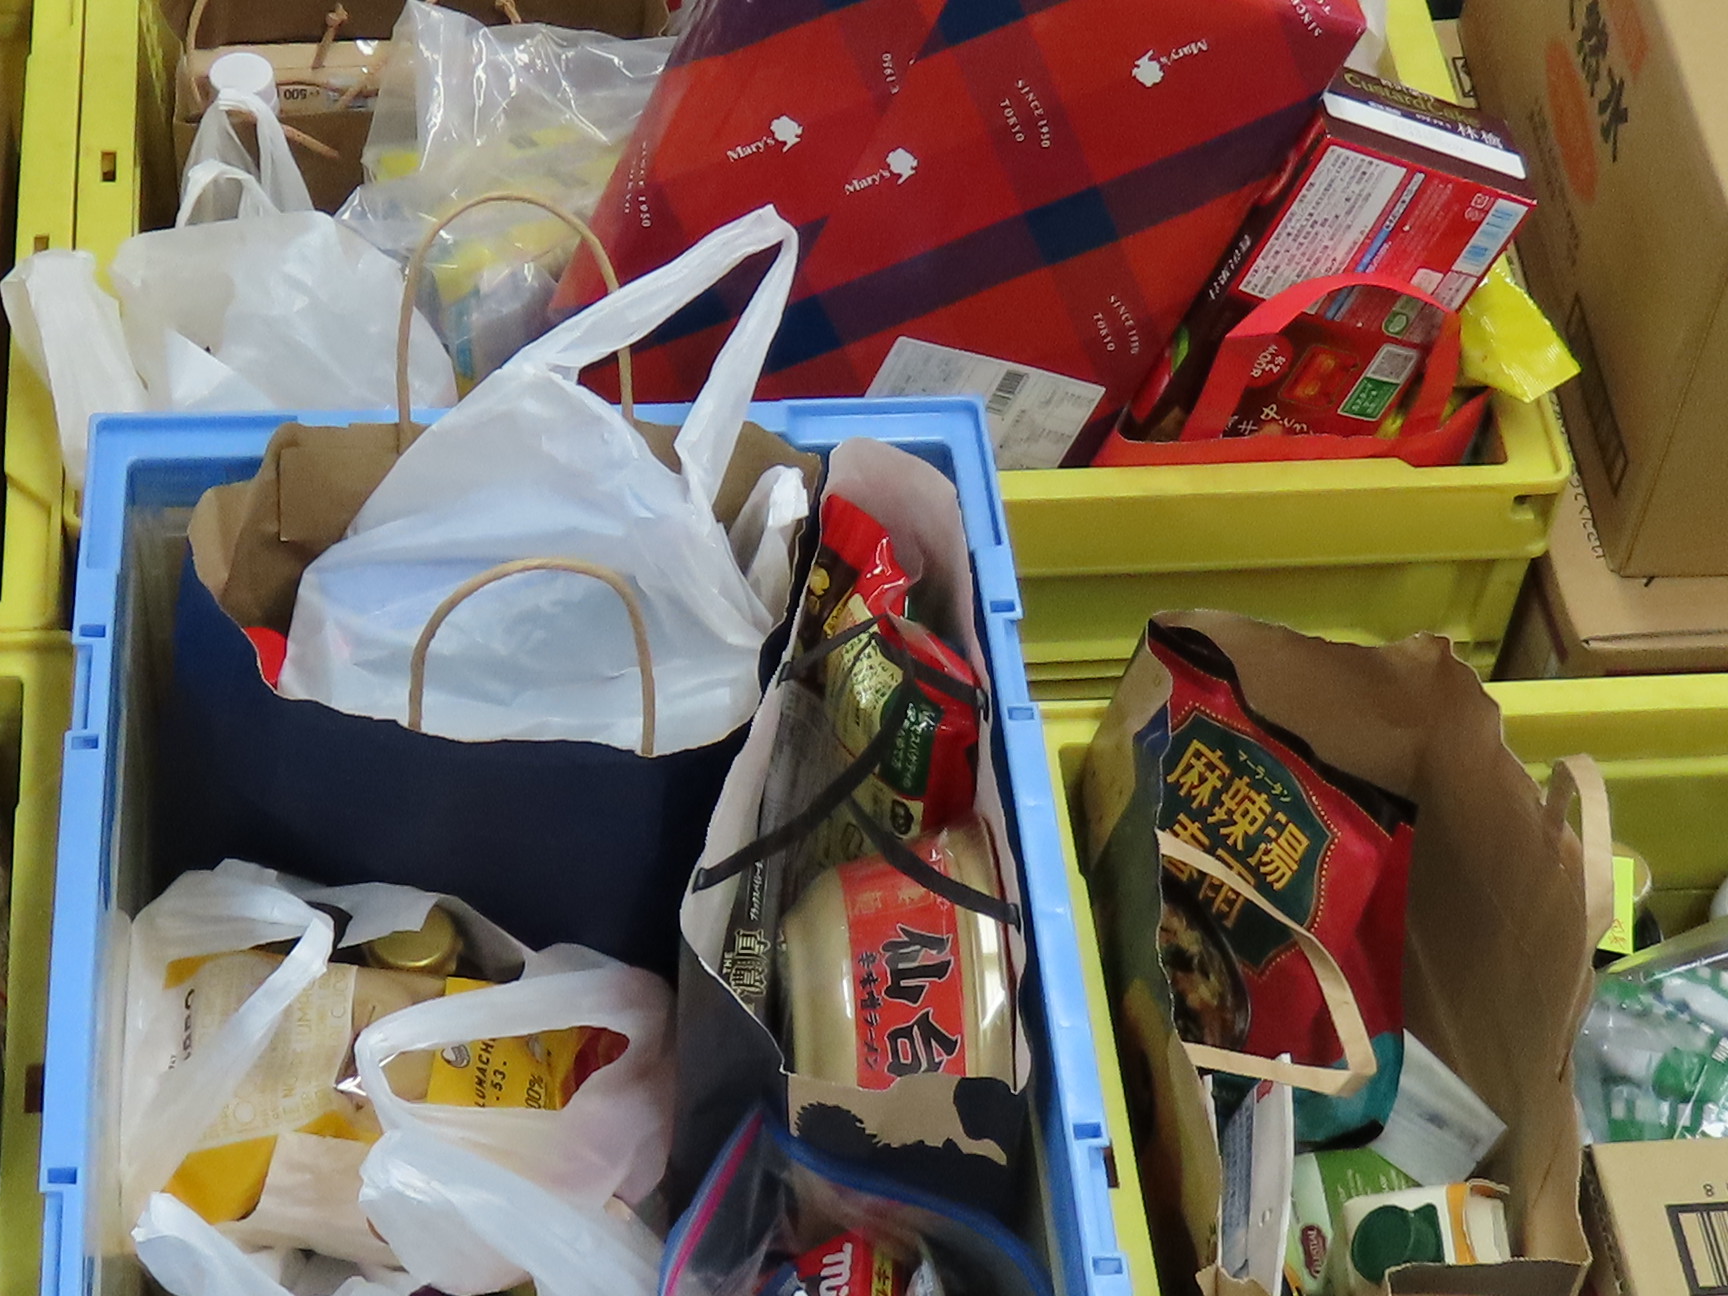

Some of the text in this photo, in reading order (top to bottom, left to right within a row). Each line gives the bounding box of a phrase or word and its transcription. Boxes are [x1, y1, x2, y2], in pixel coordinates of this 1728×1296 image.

[1158, 39, 1209, 67] Mary's
[1015, 79, 1044, 117] SINCE
[998, 97, 1026, 143] TOKYO
[726, 134, 776, 163] Mary's
[843, 168, 891, 195] Mary's
[1165, 736, 1309, 891] 麻辣湯
[879, 922, 962, 1078] 仙台
[474, 1030, 496, 1109] LUMACH
[524, 1065, 545, 1110] 00%
[1703, 1183, 1714, 1198] 8
